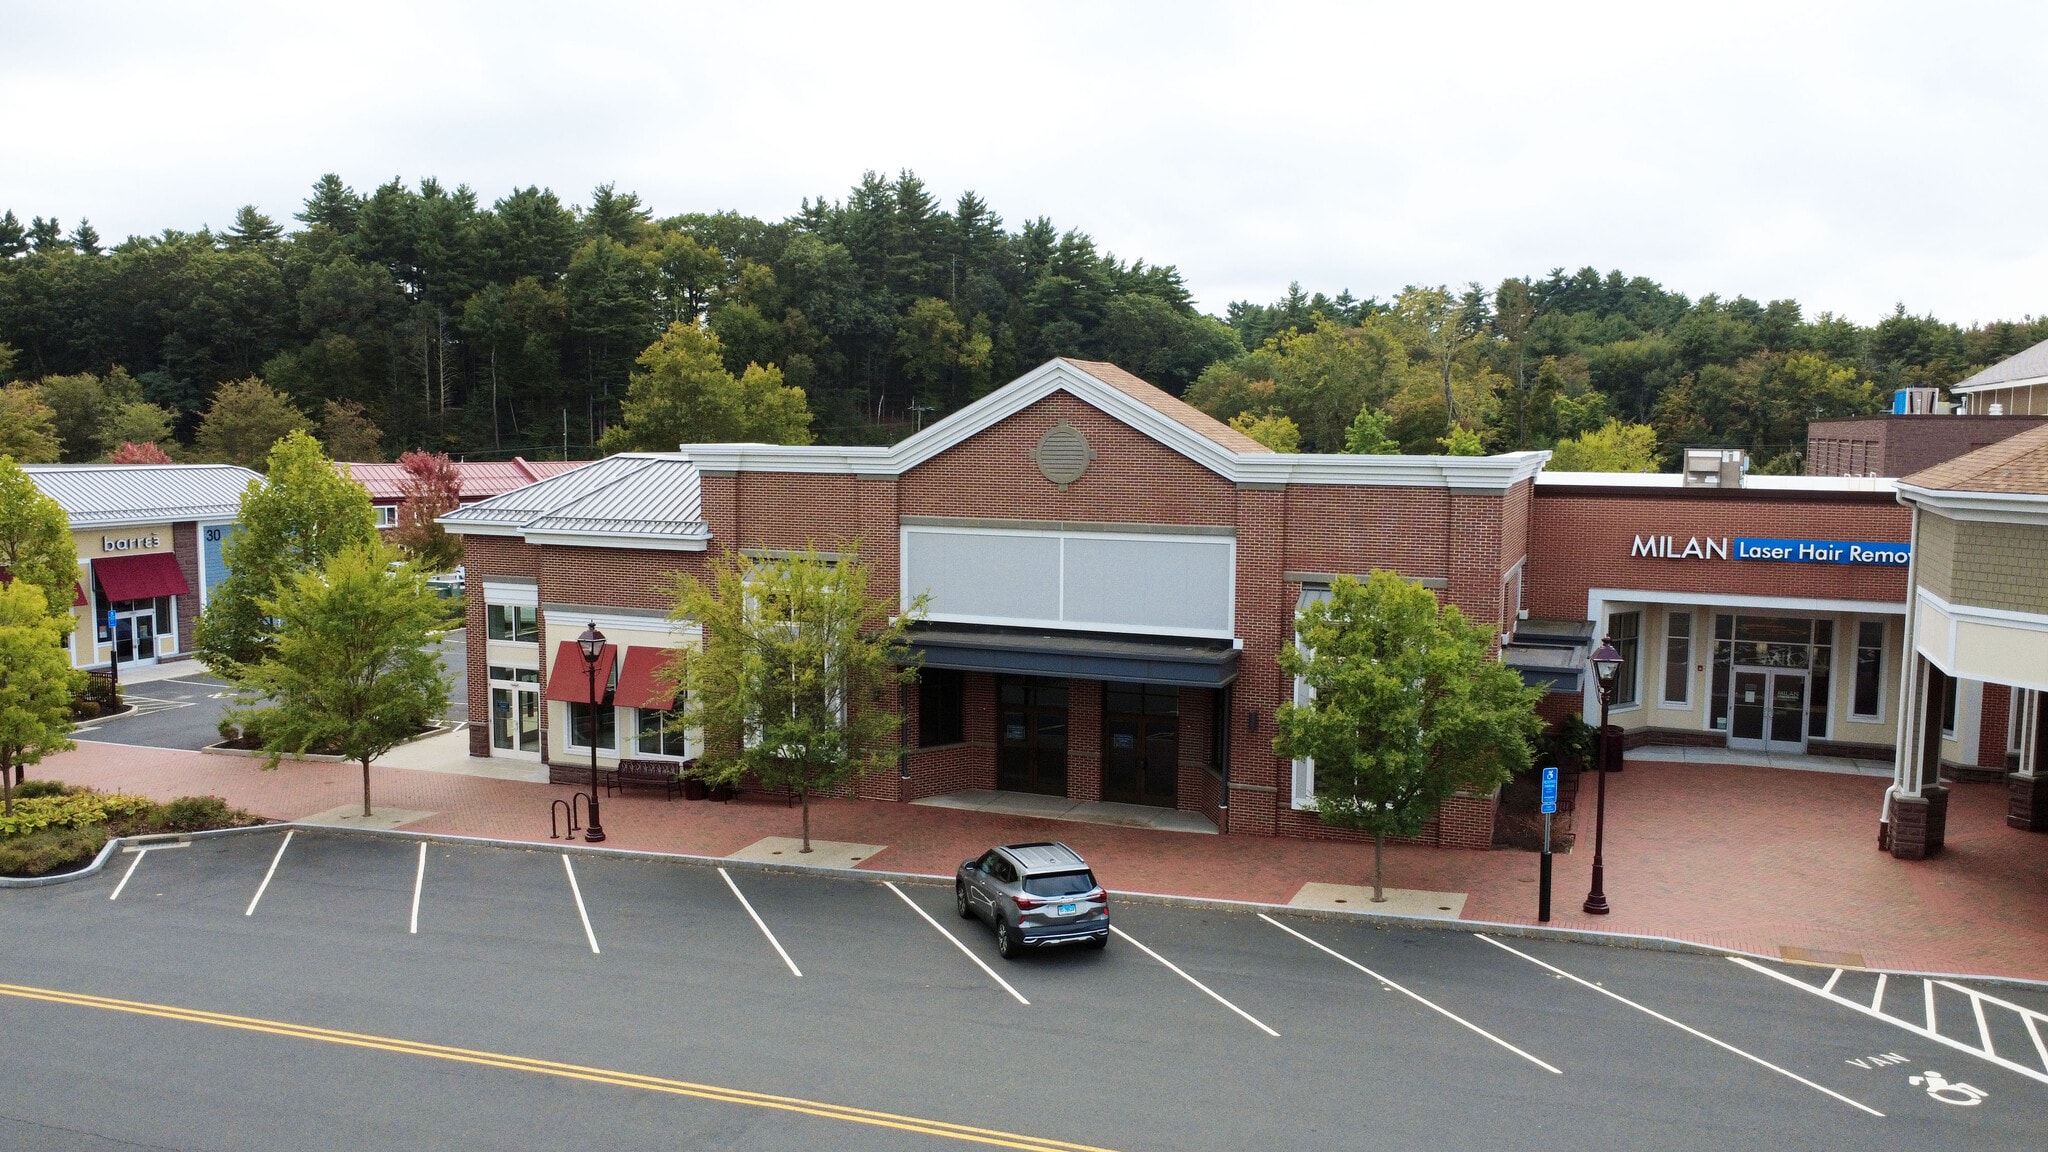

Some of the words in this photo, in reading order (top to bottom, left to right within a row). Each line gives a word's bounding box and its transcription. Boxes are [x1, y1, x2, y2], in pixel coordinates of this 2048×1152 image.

[206, 529, 221, 542] 30
[1630, 534, 1728, 560] MILAN
[1739, 541, 1793, 558] Laser
[1798, 543, 1843, 561] Hair
[1849, 545, 1911, 564] Remo
[1844, 1052, 1911, 1070] VAN
